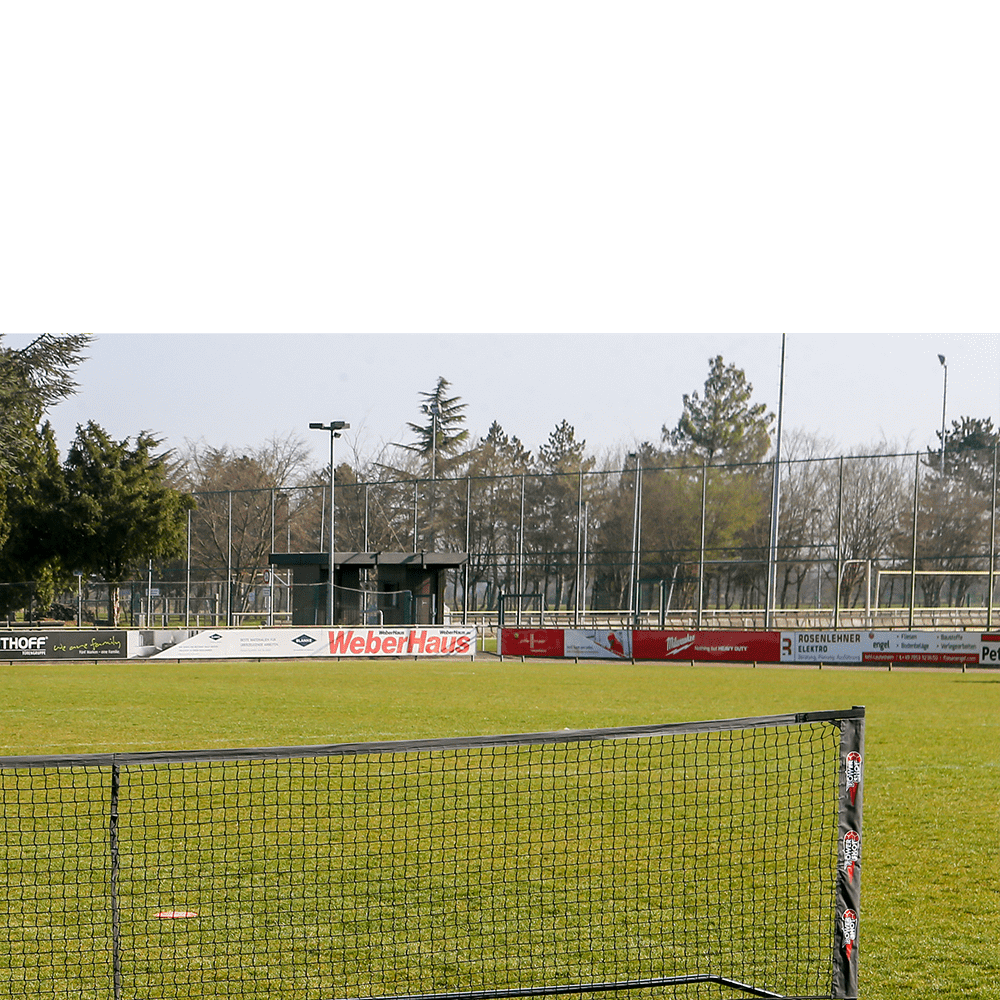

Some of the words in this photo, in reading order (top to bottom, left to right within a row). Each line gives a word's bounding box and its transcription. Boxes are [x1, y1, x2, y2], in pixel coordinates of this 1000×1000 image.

[53, 643, 66, 651] we
[90, 636, 121, 650] family
[328, 630, 471, 654] WeberHaus
[798, 634, 861, 643] ROSENLEHNER
[873, 640, 890, 651] engel
